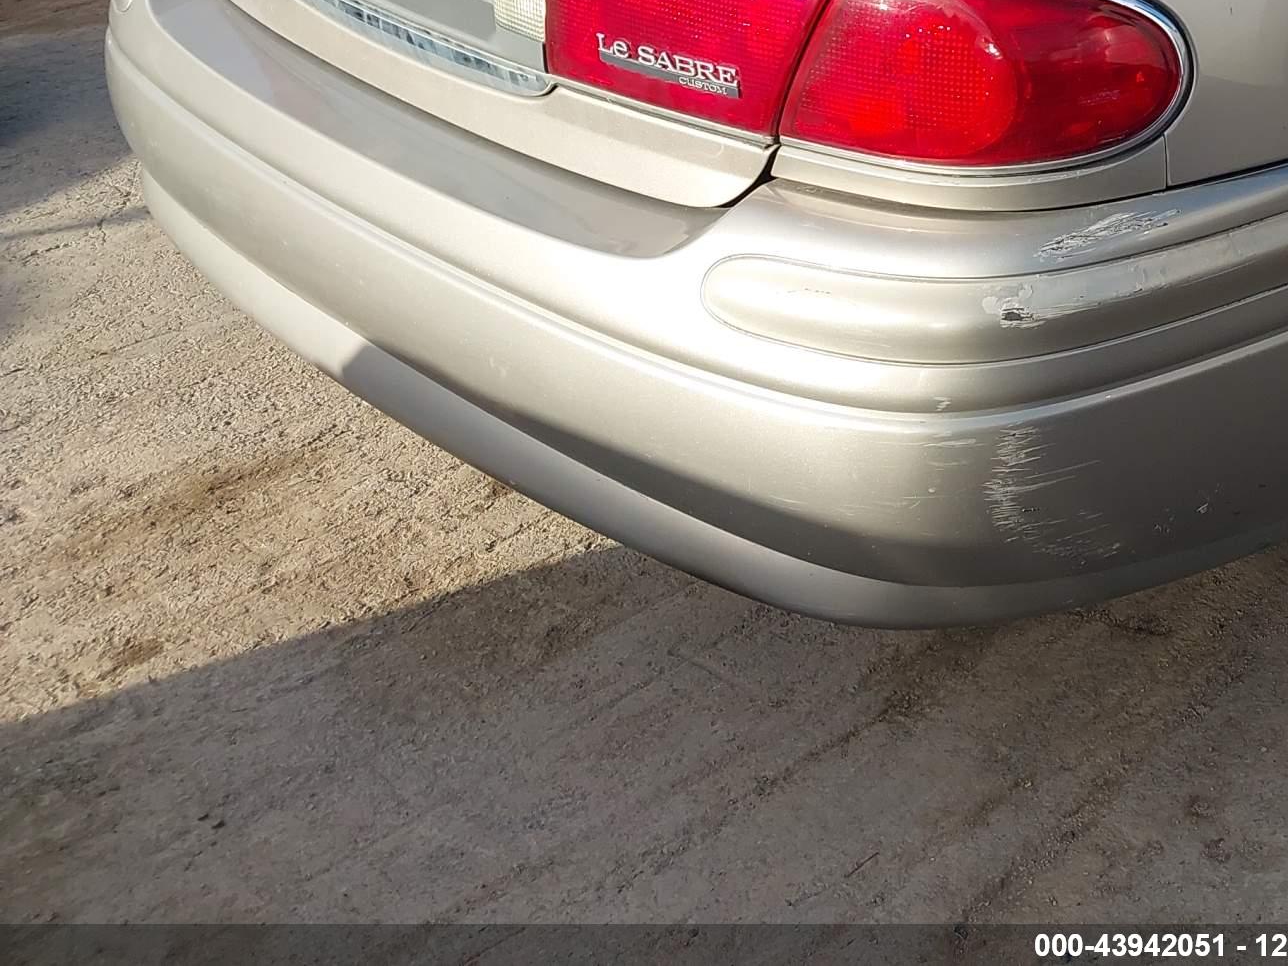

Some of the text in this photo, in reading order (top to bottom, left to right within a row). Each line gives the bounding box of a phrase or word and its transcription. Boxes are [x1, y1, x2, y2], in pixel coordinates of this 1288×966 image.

[596, 32, 738, 87] Le SABRE
[678, 75, 728, 95] CUSTOM
